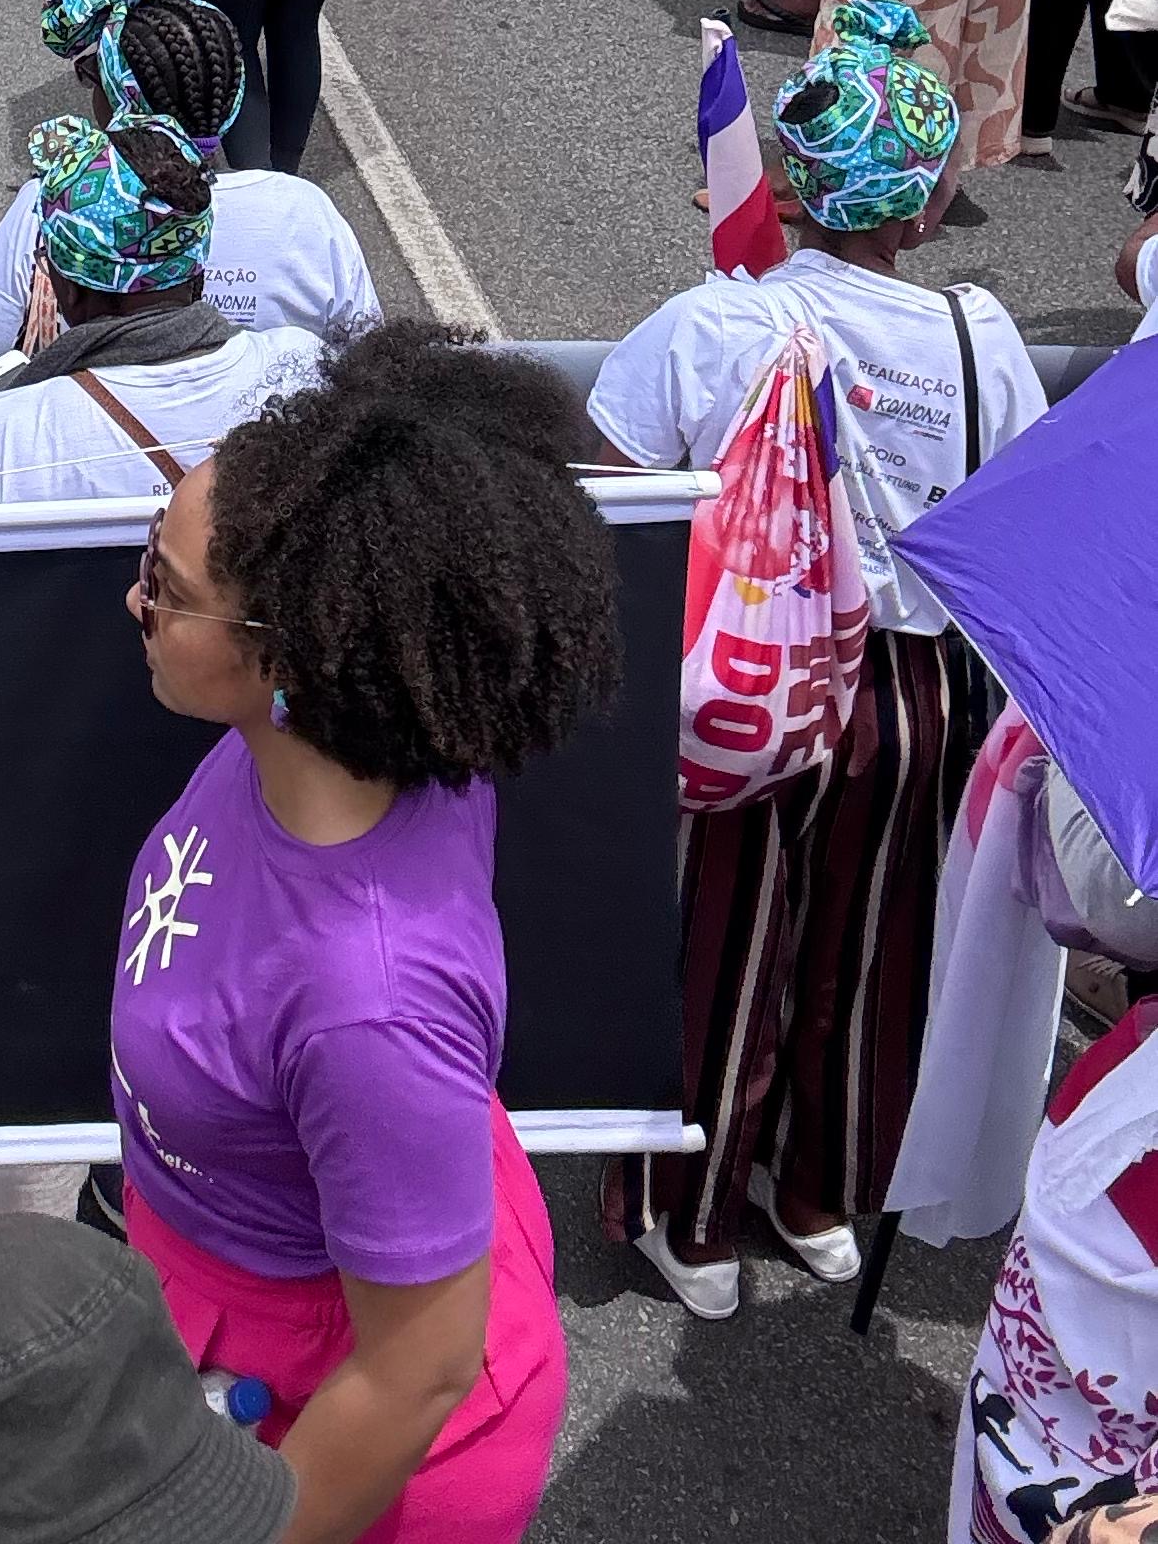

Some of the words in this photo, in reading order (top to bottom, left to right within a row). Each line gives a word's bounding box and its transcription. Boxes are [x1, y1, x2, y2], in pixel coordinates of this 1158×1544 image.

[205, 268, 257, 286] ZAÇÃO
[201, 294, 257, 311] OINONIA
[858, 360, 957, 397] REALIZAÇÃO
[875, 394, 952, 428] KOINONIA
[865, 445, 906, 466] POIO
